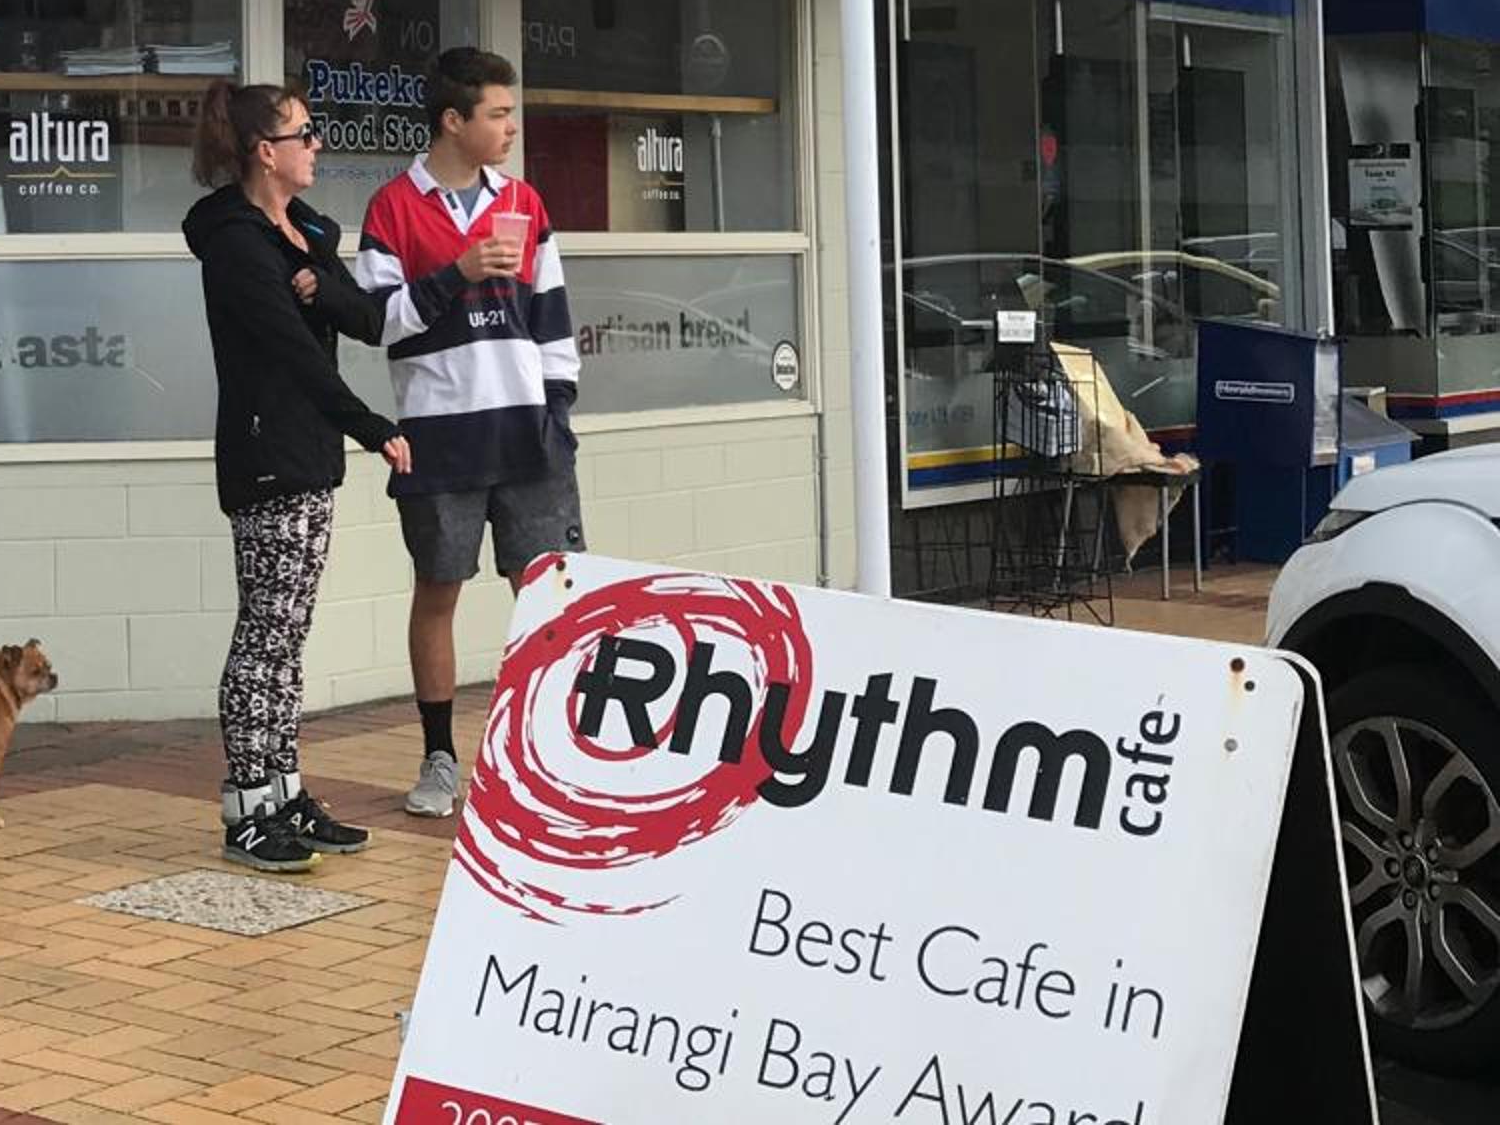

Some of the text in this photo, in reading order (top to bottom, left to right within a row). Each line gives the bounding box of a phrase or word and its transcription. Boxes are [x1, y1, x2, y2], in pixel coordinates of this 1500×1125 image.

[9, 111, 110, 163] altura
[637, 128, 683, 172] altura
[19, 181, 73, 196] coffee
[579, 308, 750, 355] artisan bread
[575, 634, 1112, 830] Rhythm
[748, 888, 1164, 1039] Best Cafe in
[474, 954, 739, 1092] Mairangi
[757, 1018, 882, 1125] Bay
